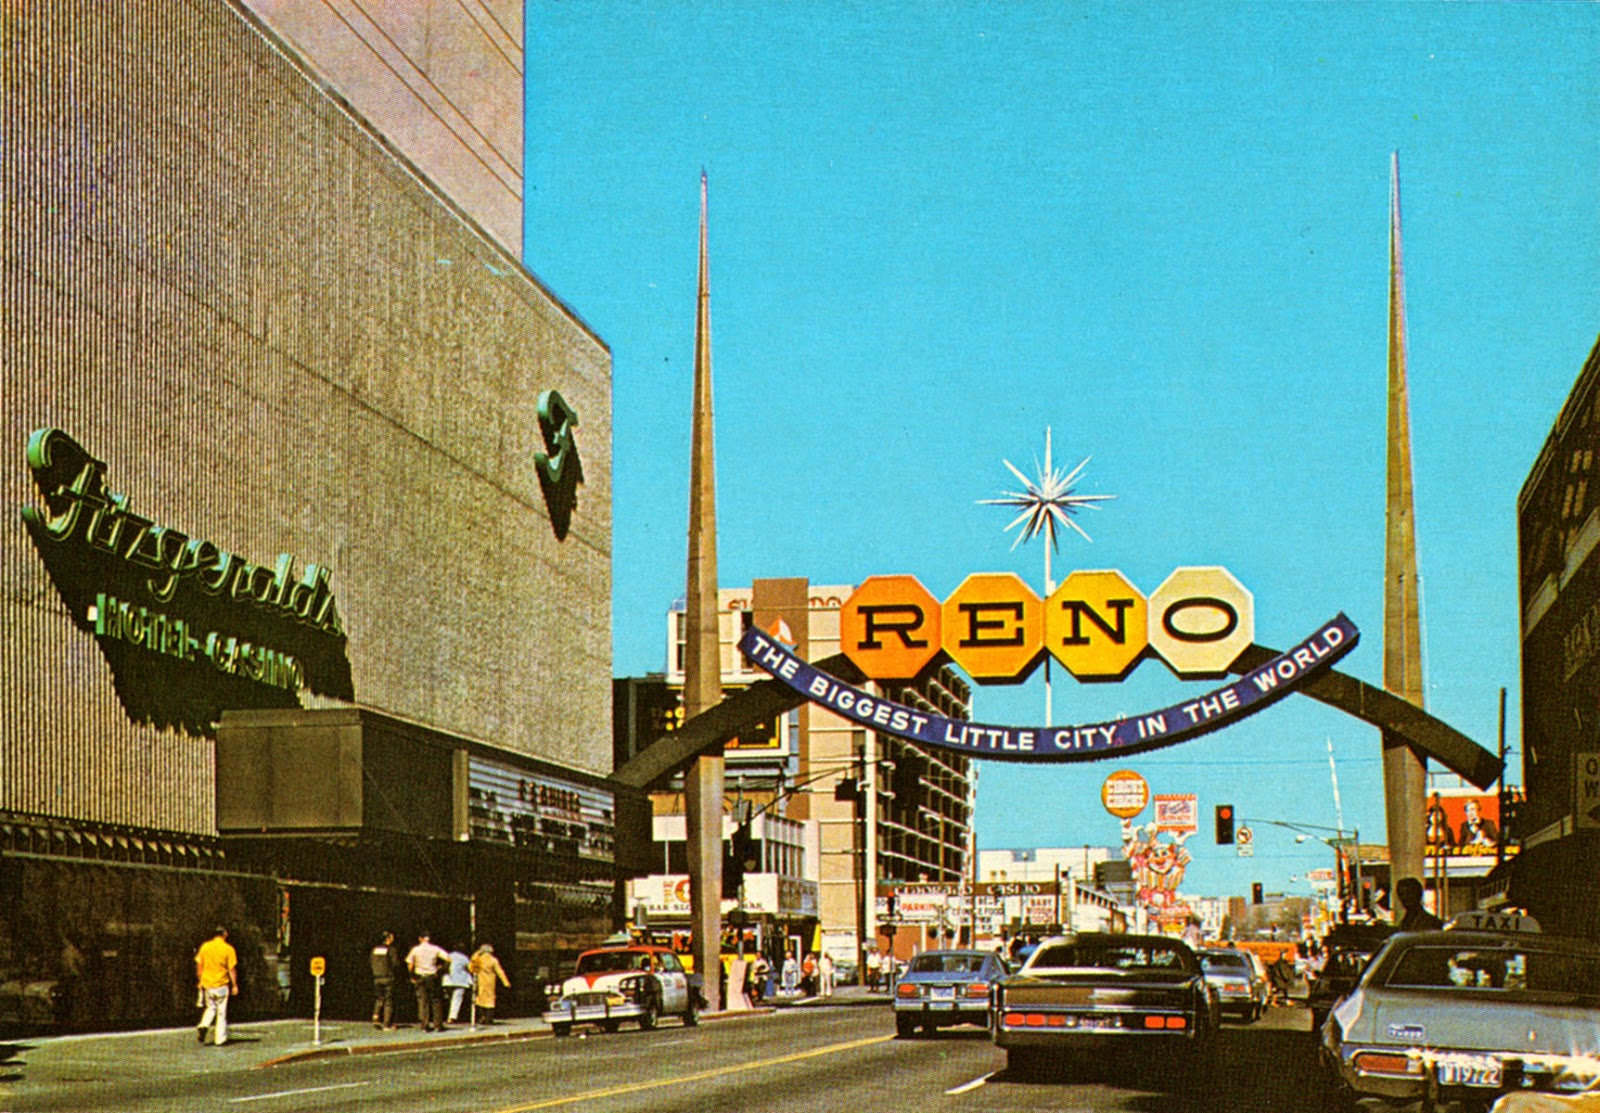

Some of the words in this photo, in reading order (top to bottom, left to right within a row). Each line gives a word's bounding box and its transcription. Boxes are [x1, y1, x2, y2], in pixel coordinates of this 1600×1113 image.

[22, 428, 342, 638] Fitzgeralds
[857, 597, 1239, 650] RENO
[751, 636, 801, 680] THE
[808, 676, 929, 735] BIGGEST
[944, 723, 1035, 751] LITTLE
[1054, 723, 1119, 749] CITY
[1137, 714, 1168, 738] IN
[1182, 688, 1241, 724] THE
[1253, 625, 1344, 693] WORLD
[1471, 914, 1520, 930] TAXI
